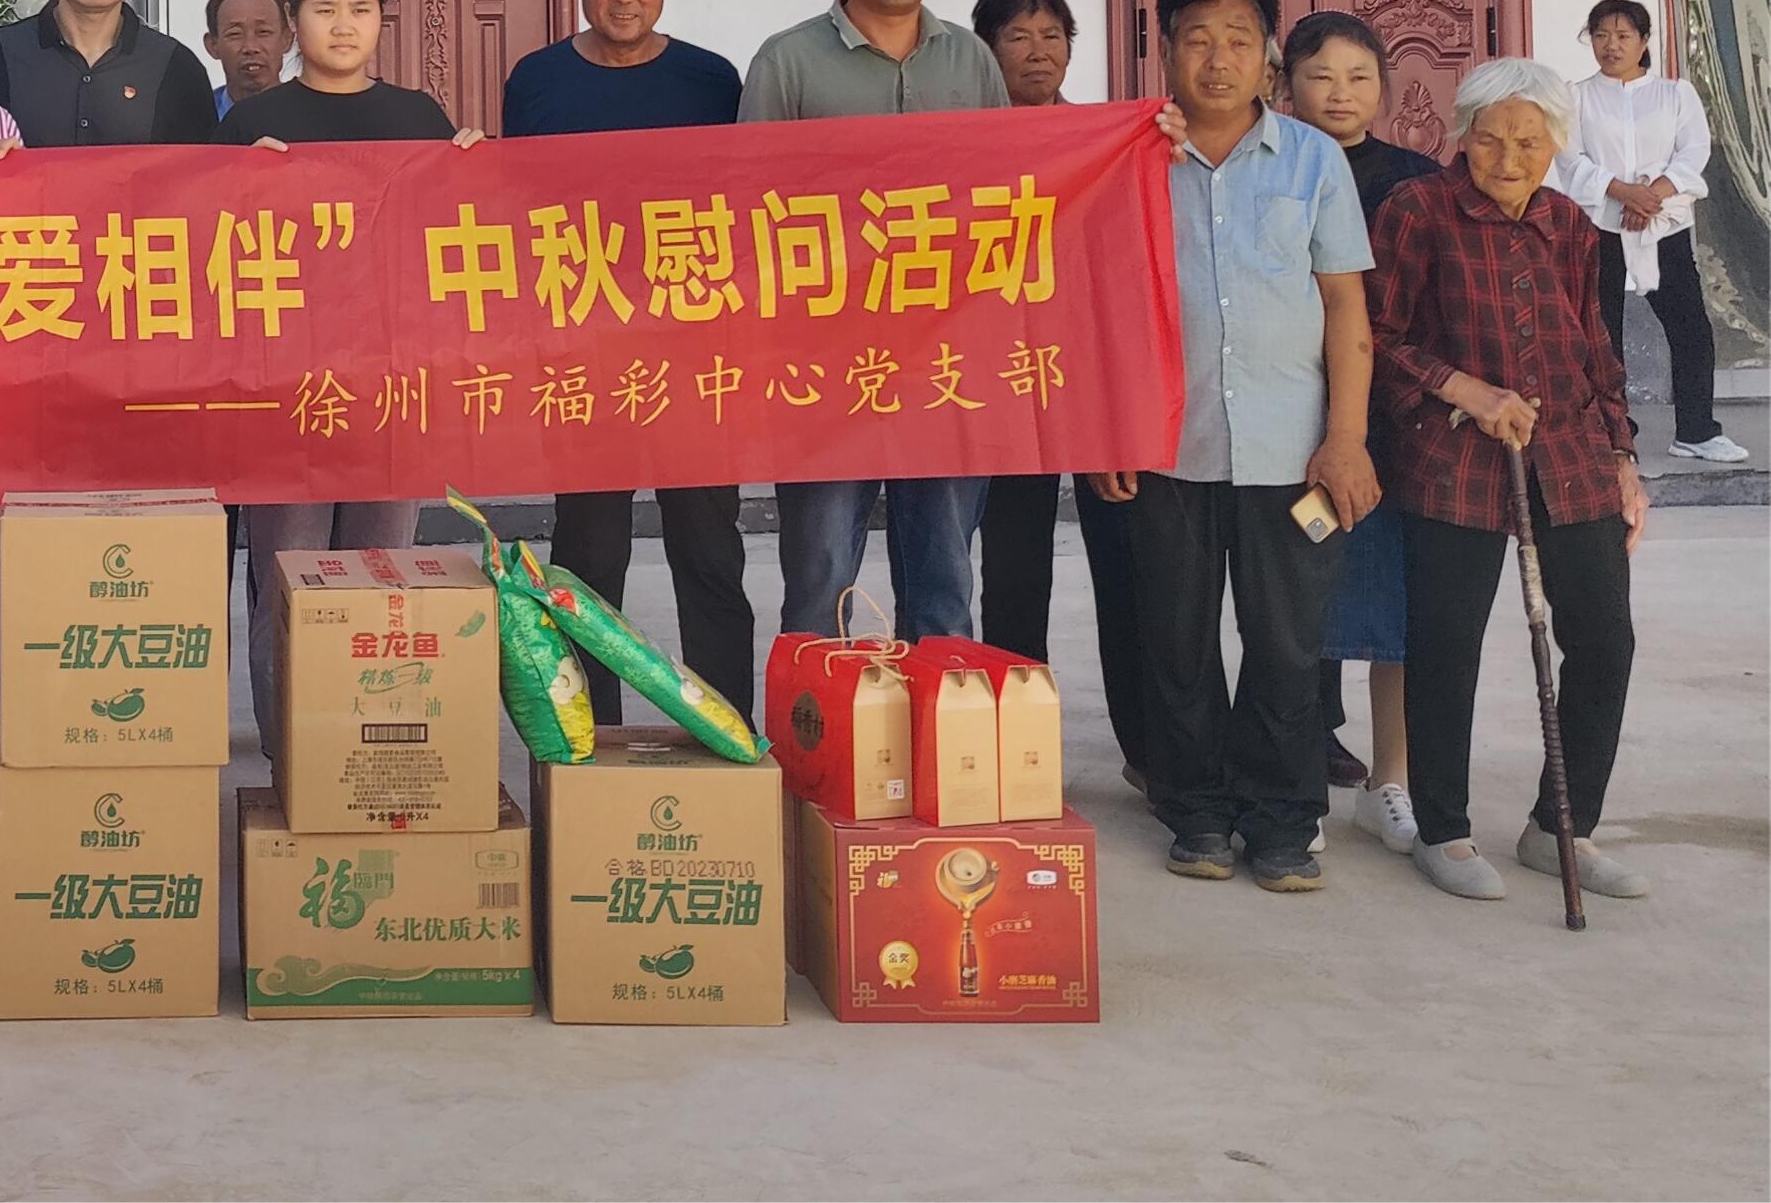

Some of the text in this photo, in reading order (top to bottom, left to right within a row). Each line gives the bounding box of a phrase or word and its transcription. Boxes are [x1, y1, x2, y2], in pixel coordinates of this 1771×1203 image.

[424, 174, 1058, 333] 中秋慰问活动
[89, 581, 150, 598] 醇油坊
[23, 624, 214, 670] 一级大豆油
[351, 632, 440, 659] 金龙鱼
[351, 696, 442, 718] 大豆油
[365, 811, 430, 822] 净含量升X4
[81, 831, 141, 848] 醇油坊
[637, 833, 698, 851] 醇油坊
[15, 873, 203, 920] 一级大豆油
[571, 878, 763, 926] 一级大豆油
[374, 915, 522, 942] 东北优质大米
